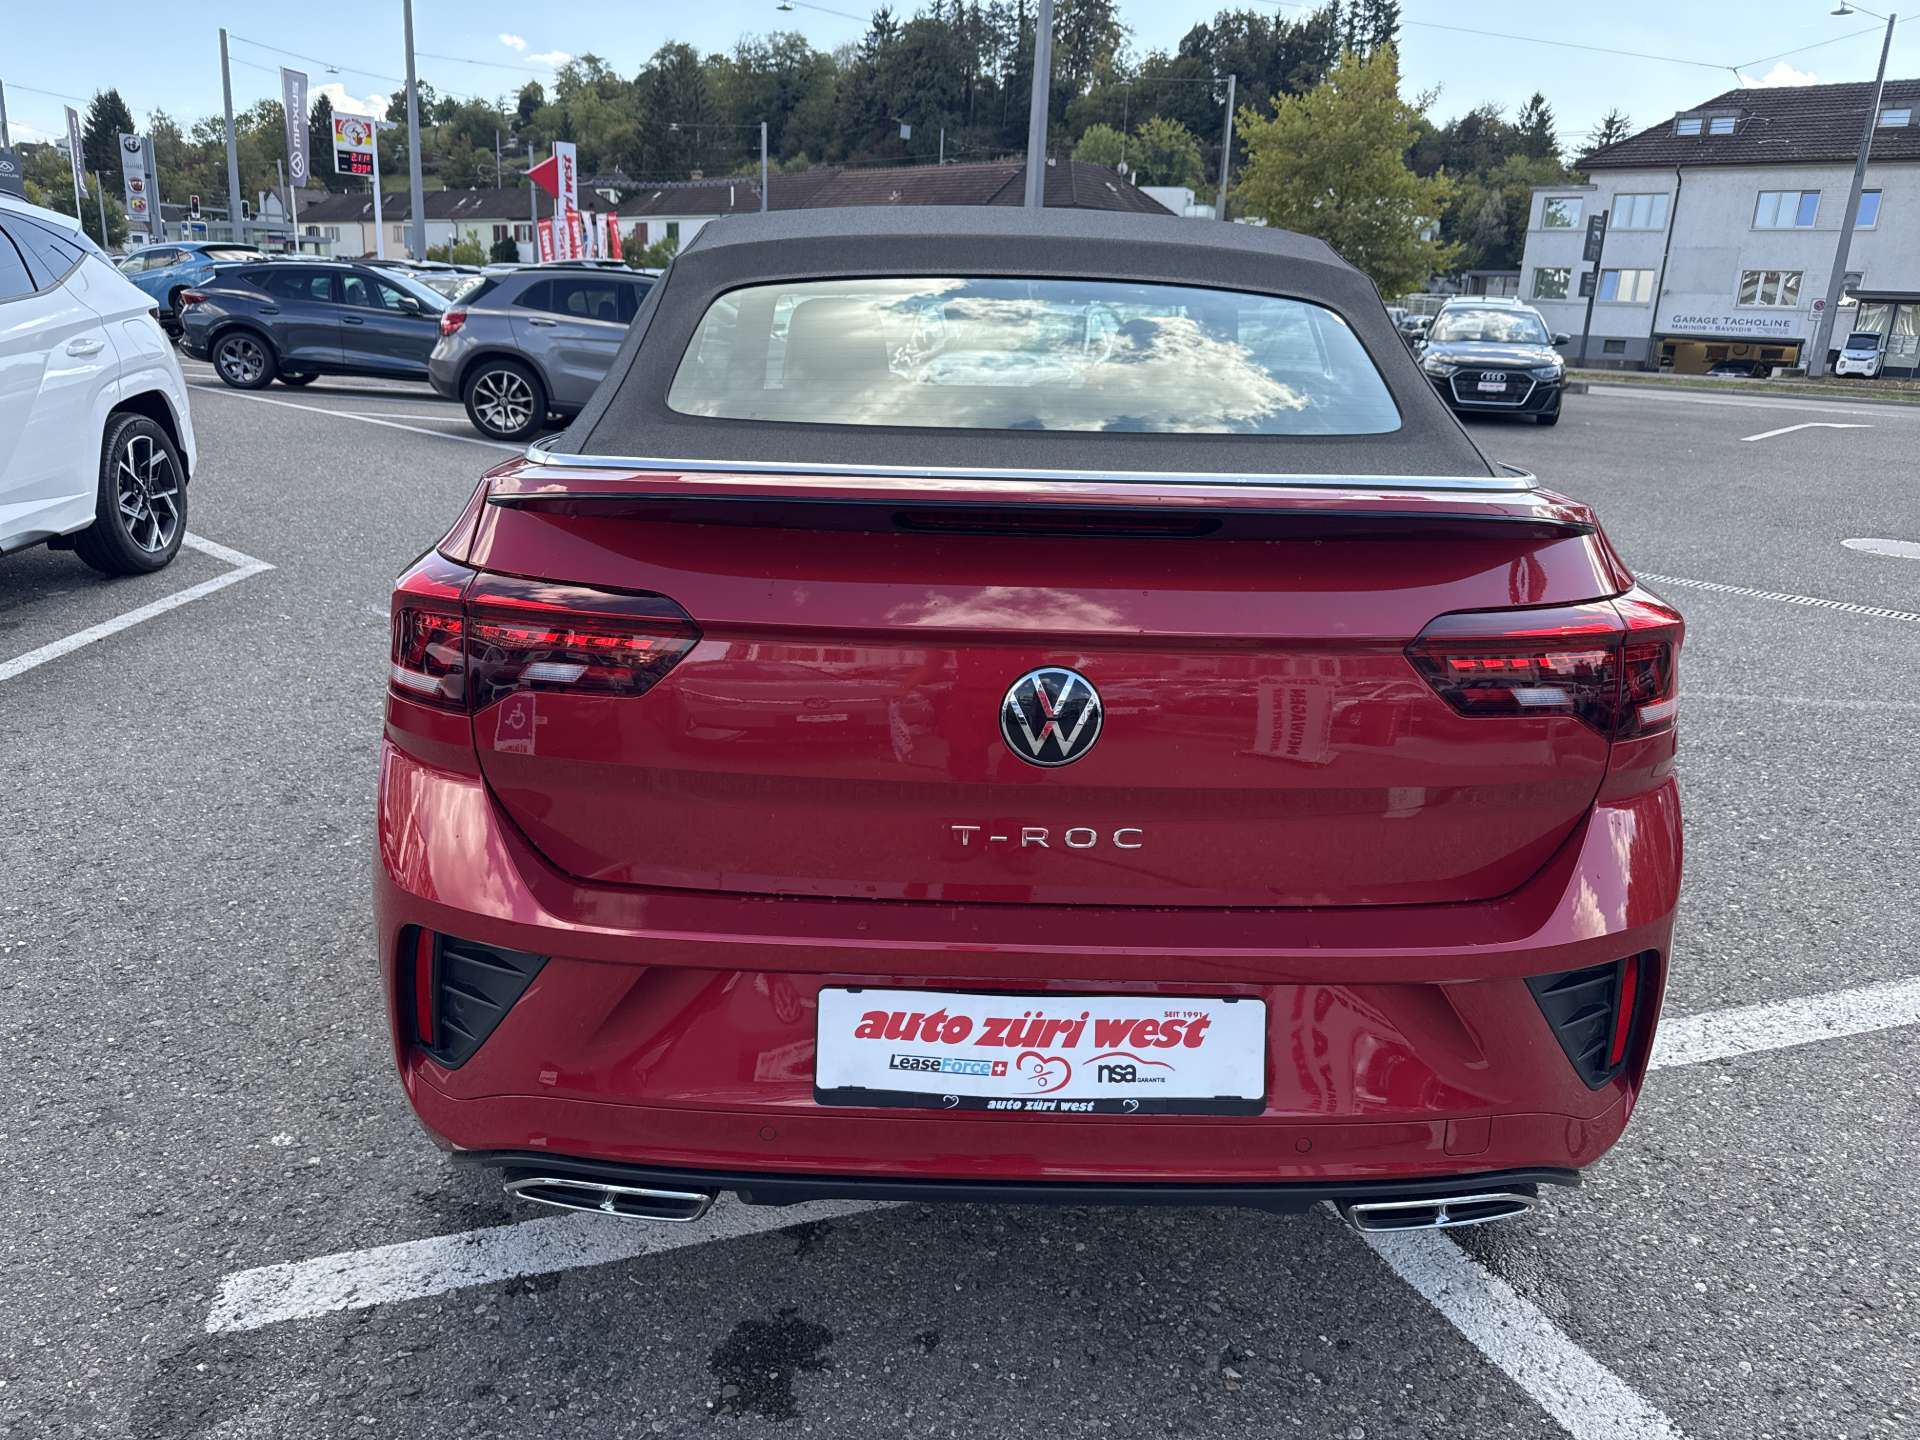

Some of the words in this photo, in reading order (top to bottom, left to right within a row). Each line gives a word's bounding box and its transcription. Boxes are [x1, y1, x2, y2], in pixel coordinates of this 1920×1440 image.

[291, 80, 301, 148] MAXUS
[1672, 314, 1718, 325] GARAGE
[1723, 316, 1792, 328] TACHOLINE
[951, 825, 1144, 848] T-ROC
[854, 1008, 973, 1045] auto
[974, 1011, 1090, 1048] züri
[1094, 1013, 1212, 1048] west
[889, 1054, 991, 1075] LeaseForce
[1097, 1064, 1137, 1083] nsa
[987, 1099, 1022, 1110] auto
[1024, 1100, 1057, 1111] züri
[1060, 1101, 1095, 1111] west
